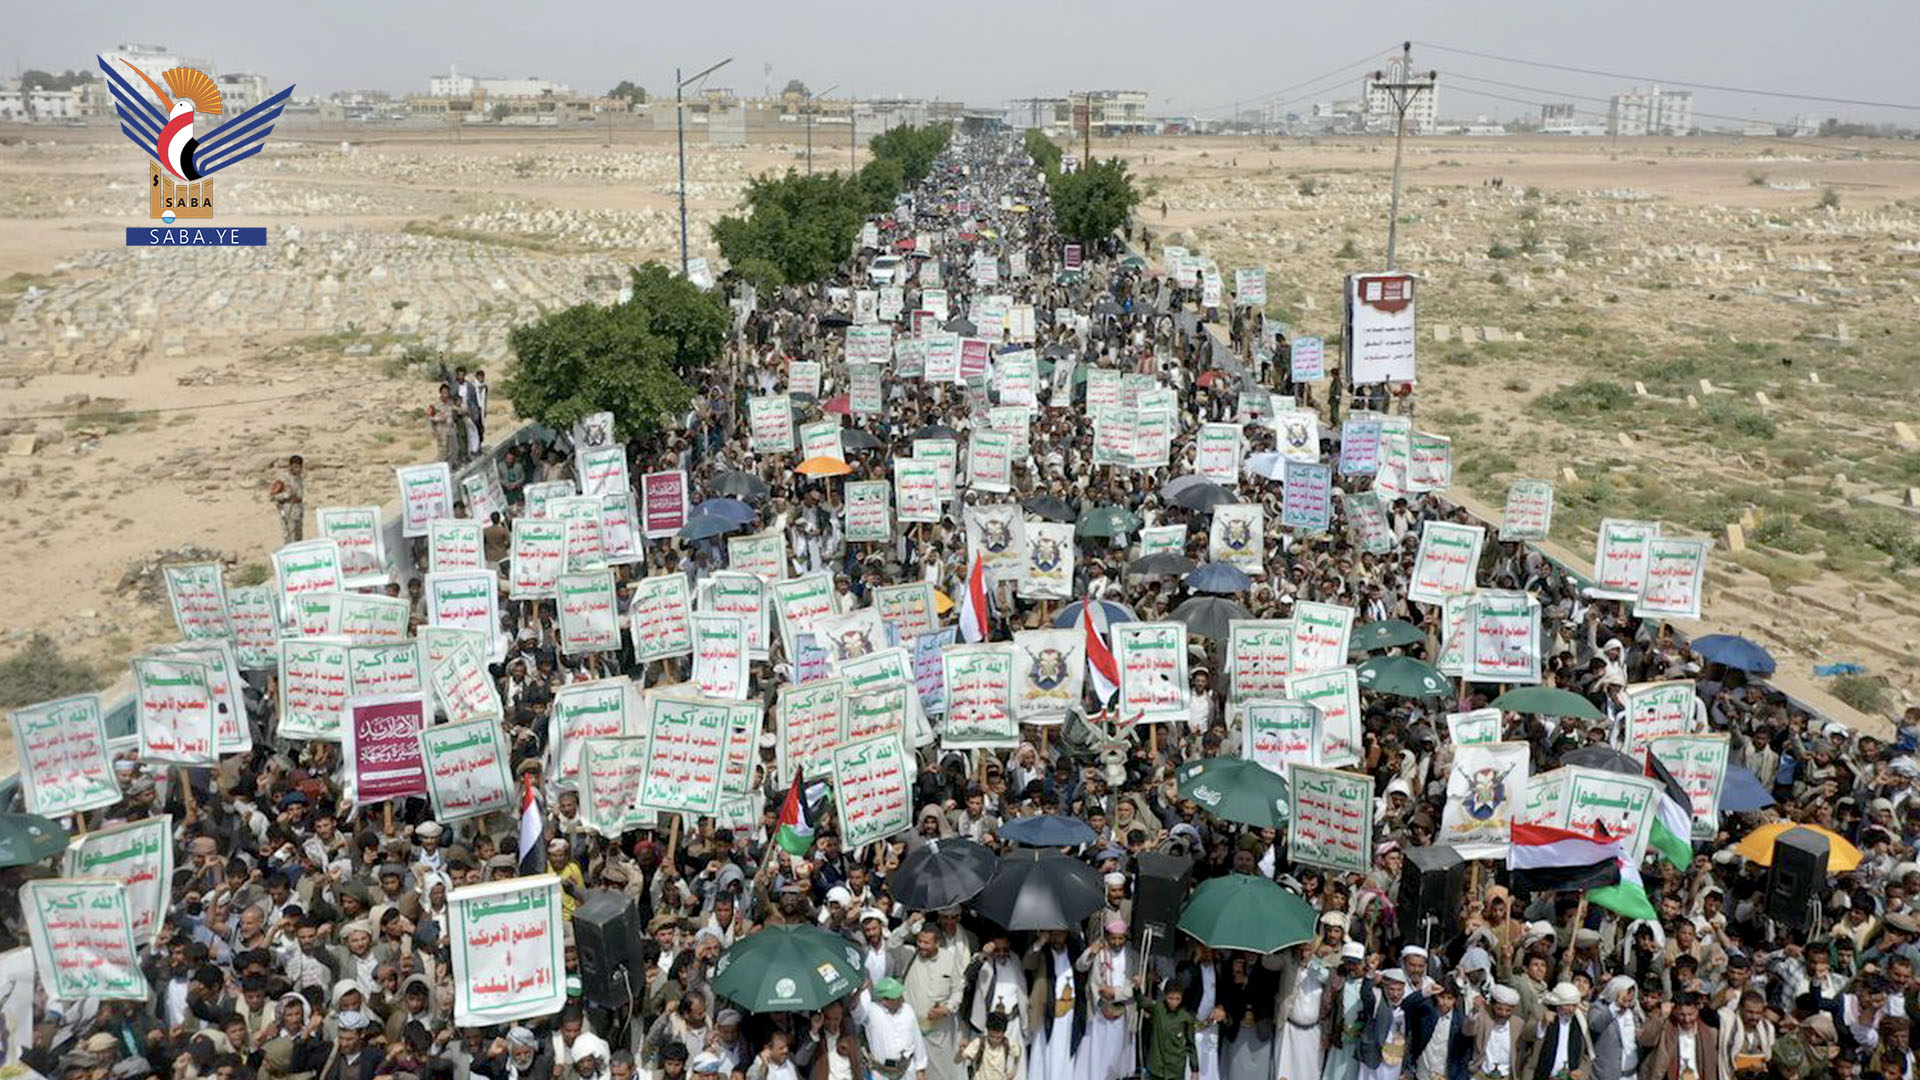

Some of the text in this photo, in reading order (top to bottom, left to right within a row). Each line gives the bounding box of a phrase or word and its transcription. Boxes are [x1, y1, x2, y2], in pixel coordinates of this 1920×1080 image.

[393, 648, 416, 663] الله
[700, 711, 724, 727] الله
[1254, 714, 1310, 733] قاطعوا
[429, 727, 492, 758] قاطعوا
[876, 742, 897, 759] الله
[1339, 784, 1364, 800] الله
[1576, 785, 1645, 812] قاطعوا
[467, 887, 547, 923] قاطعوا
